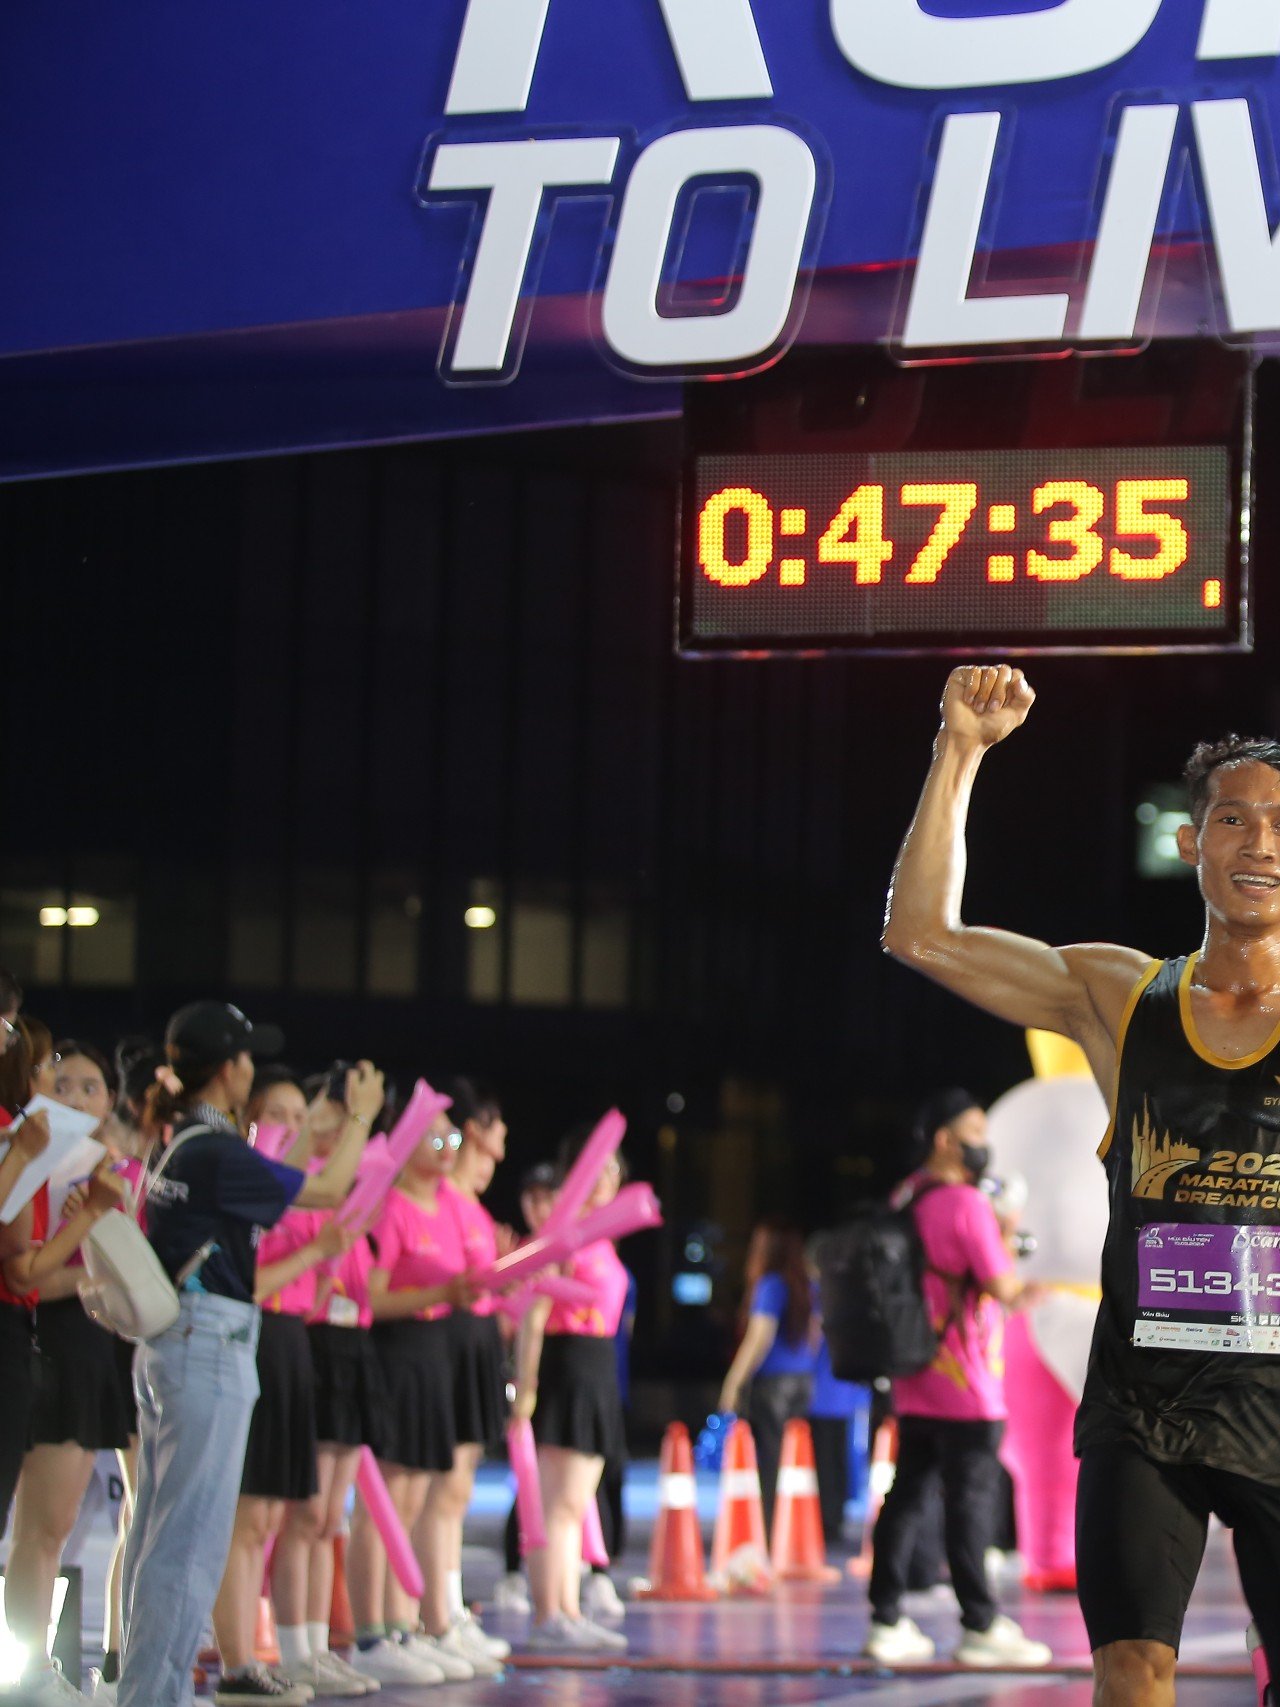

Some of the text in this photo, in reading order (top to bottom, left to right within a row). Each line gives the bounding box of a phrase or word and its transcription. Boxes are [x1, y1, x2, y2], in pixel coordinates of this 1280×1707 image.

[428, 124, 816, 371] TO
[697, 477, 1189, 587] 0:47:35
[1174, 1189, 1260, 1208] DREAM
